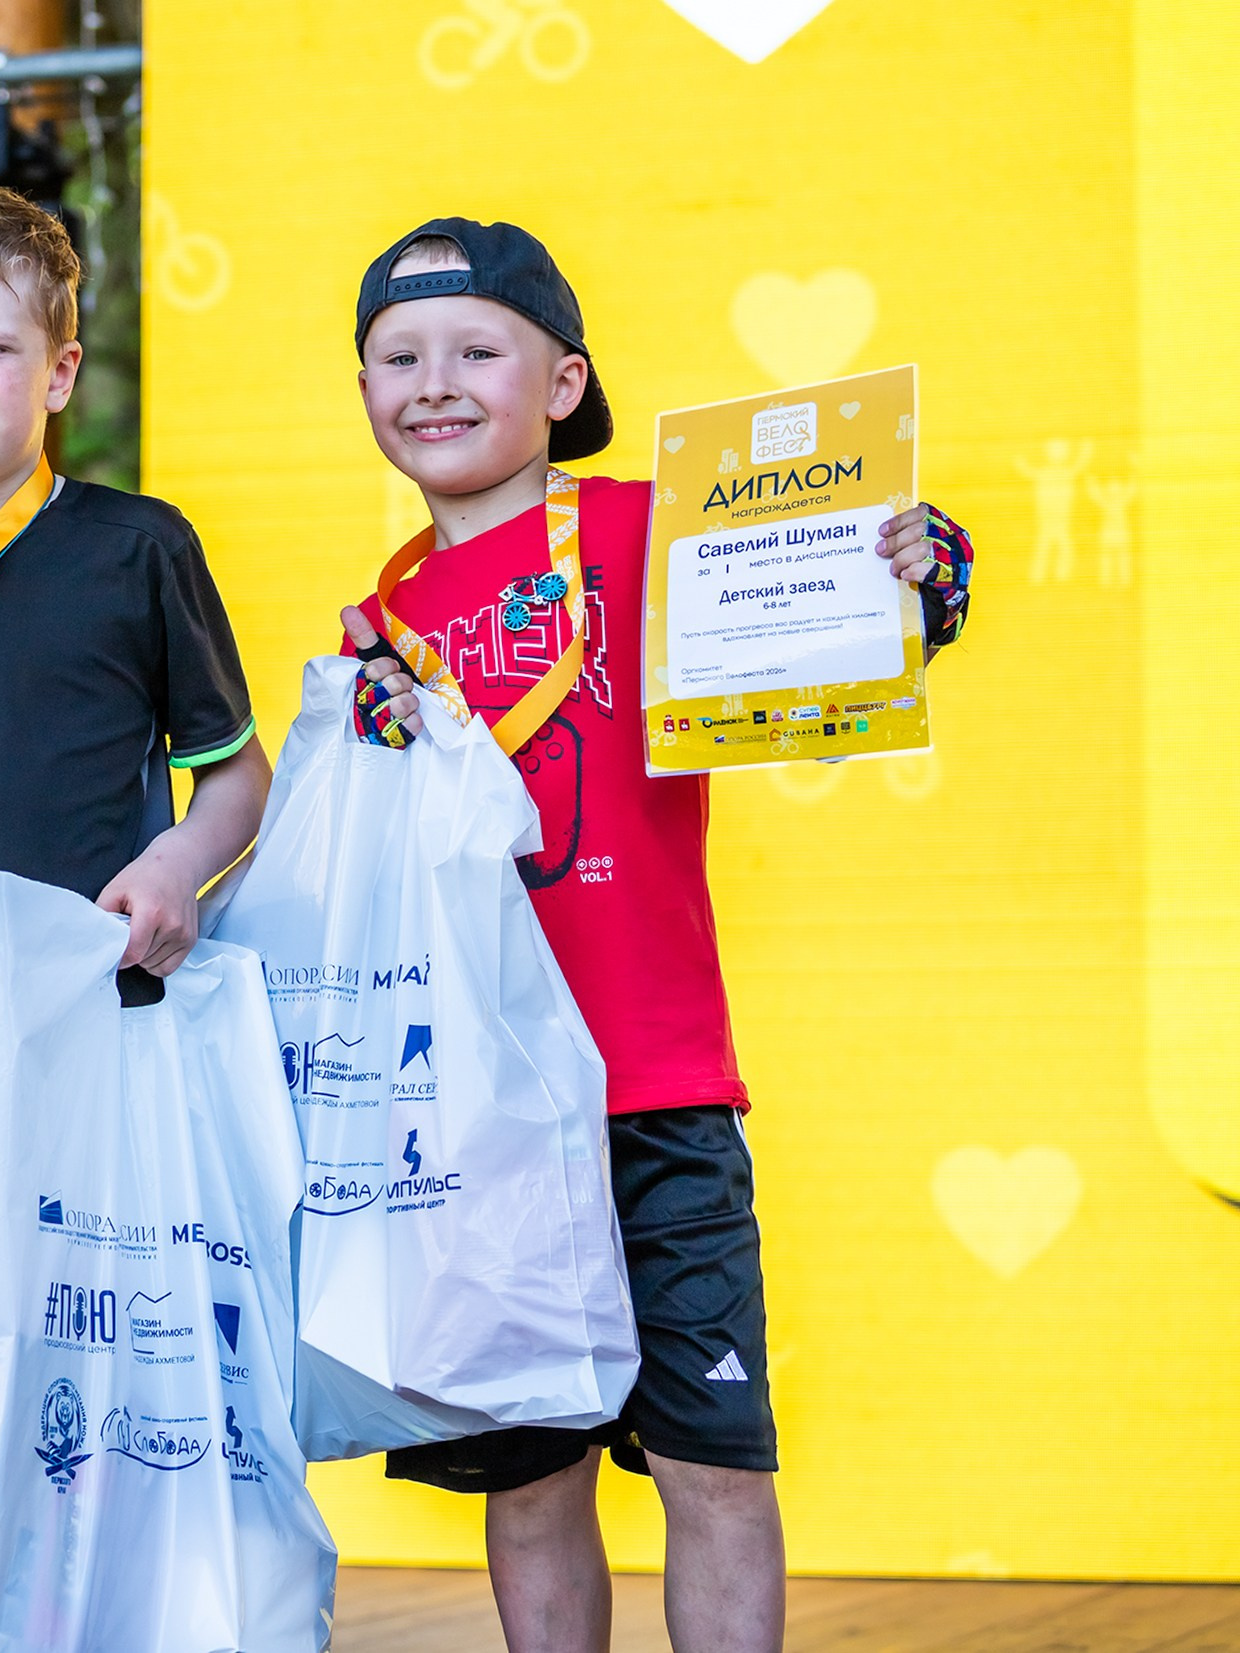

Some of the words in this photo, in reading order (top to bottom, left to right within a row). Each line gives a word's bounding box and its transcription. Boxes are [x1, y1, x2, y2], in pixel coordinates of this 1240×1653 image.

[758, 408, 808, 425] ПЕРМСКИЙ
[757, 420, 811, 442] ВЕЛО
[703, 456, 862, 512] ДИПЛОМ
[732, 495, 830, 519] награждается
[698, 532, 779, 559] Савелий
[786, 524, 856, 546] Шуман
[698, 568, 710, 576] за
[750, 557, 783, 568] место
[794, 544, 864, 562] дисциплине
[719, 582, 784, 605] Детский
[789, 579, 836, 594] заезд
[763, 601, 776, 610] 6-8
[778, 600, 791, 608] лет
[580, 870, 612, 884] VOL.1
[270, 967, 321, 985] ОПОР
[322, 964, 359, 986] СИИ
[314, 1059, 352, 1071] МАГАЗИН
[340, 1100, 380, 1108] АХМЕТОВОЙ
[427, 1199, 446, 1210] ЦЕНТР
[66, 1210, 116, 1233] ОПОРА
[88, 1346, 116, 1355] центр
